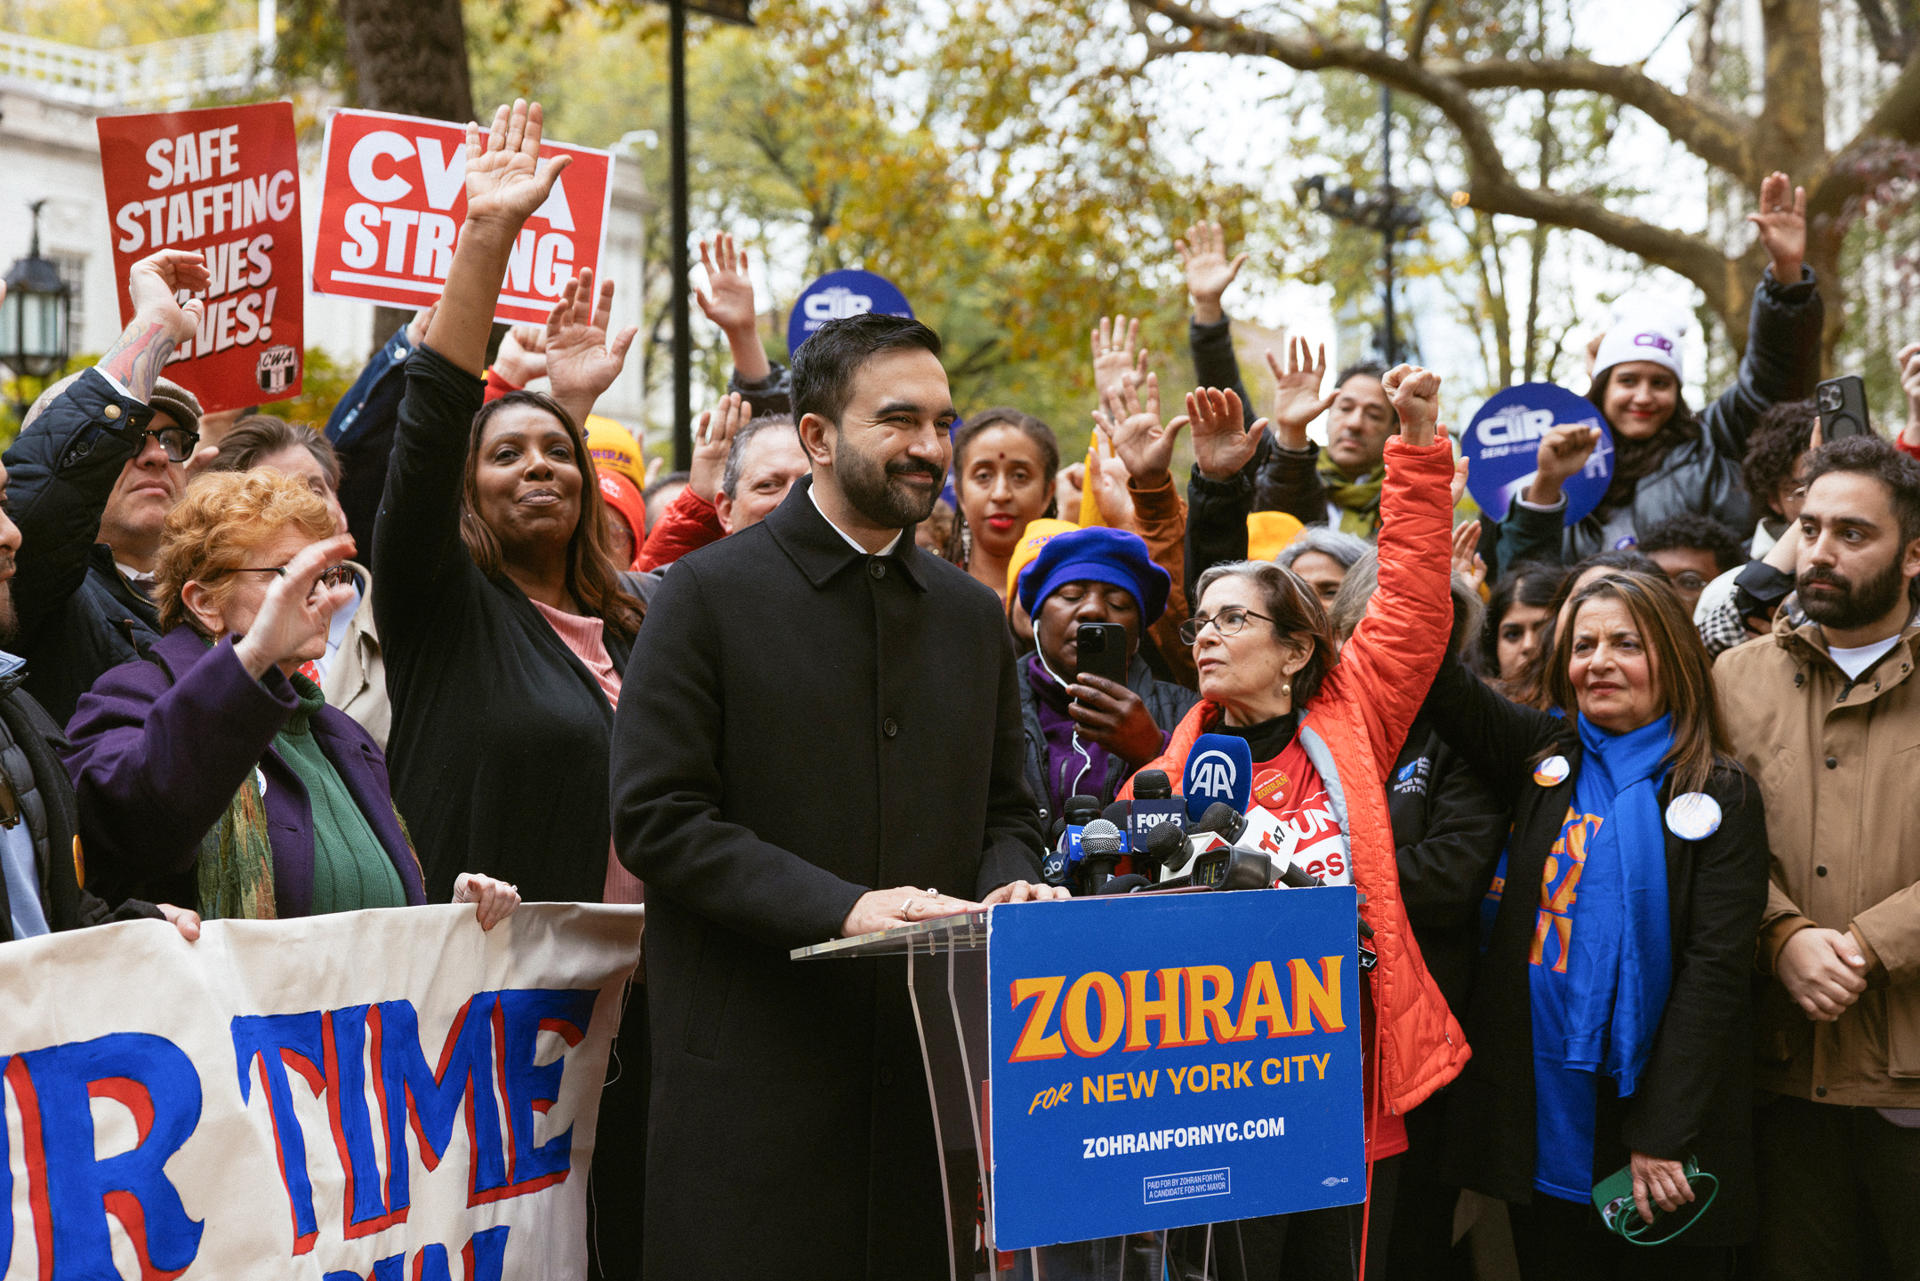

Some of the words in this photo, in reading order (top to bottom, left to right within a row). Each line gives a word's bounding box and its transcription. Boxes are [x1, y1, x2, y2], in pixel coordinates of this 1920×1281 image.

[145, 124, 240, 191] SAFE
[116, 169, 295, 254] STAFFING
[341, 202, 574, 298] STRNG
[262, 350, 293, 368] CWA
[1189, 763, 1234, 799] AA
[1273, 825, 1285, 845] 47
[1043, 859, 1064, 877] ab
[1300, 852, 1345, 881] es
[1008, 955, 1346, 1063] ZOHRAN
[1028, 1082, 1072, 1115] FOR
[1082, 1070, 1159, 1104] NEW
[1166, 1060, 1253, 1095] YORK
[1261, 1053, 1331, 1086] CITY
[231, 988, 600, 1257] TIME
[1083, 1117, 1285, 1159] ZOHRANFORNYC.COM
[1147, 1181, 1160, 1190] PAID
[1160, 1180, 1171, 1188] FOR
[1171, 1179, 1179, 1187] BY
[1179, 1175, 1202, 1186] ZOHRAN
[1202, 1174, 1213, 1183] FOR
[1153, 1186, 1184, 1199] CANDIDATE
[1184, 1185, 1195, 1194] FOR
[1195, 1184, 1207, 1193] NYC
[1207, 1181, 1226, 1191] MAYOR
